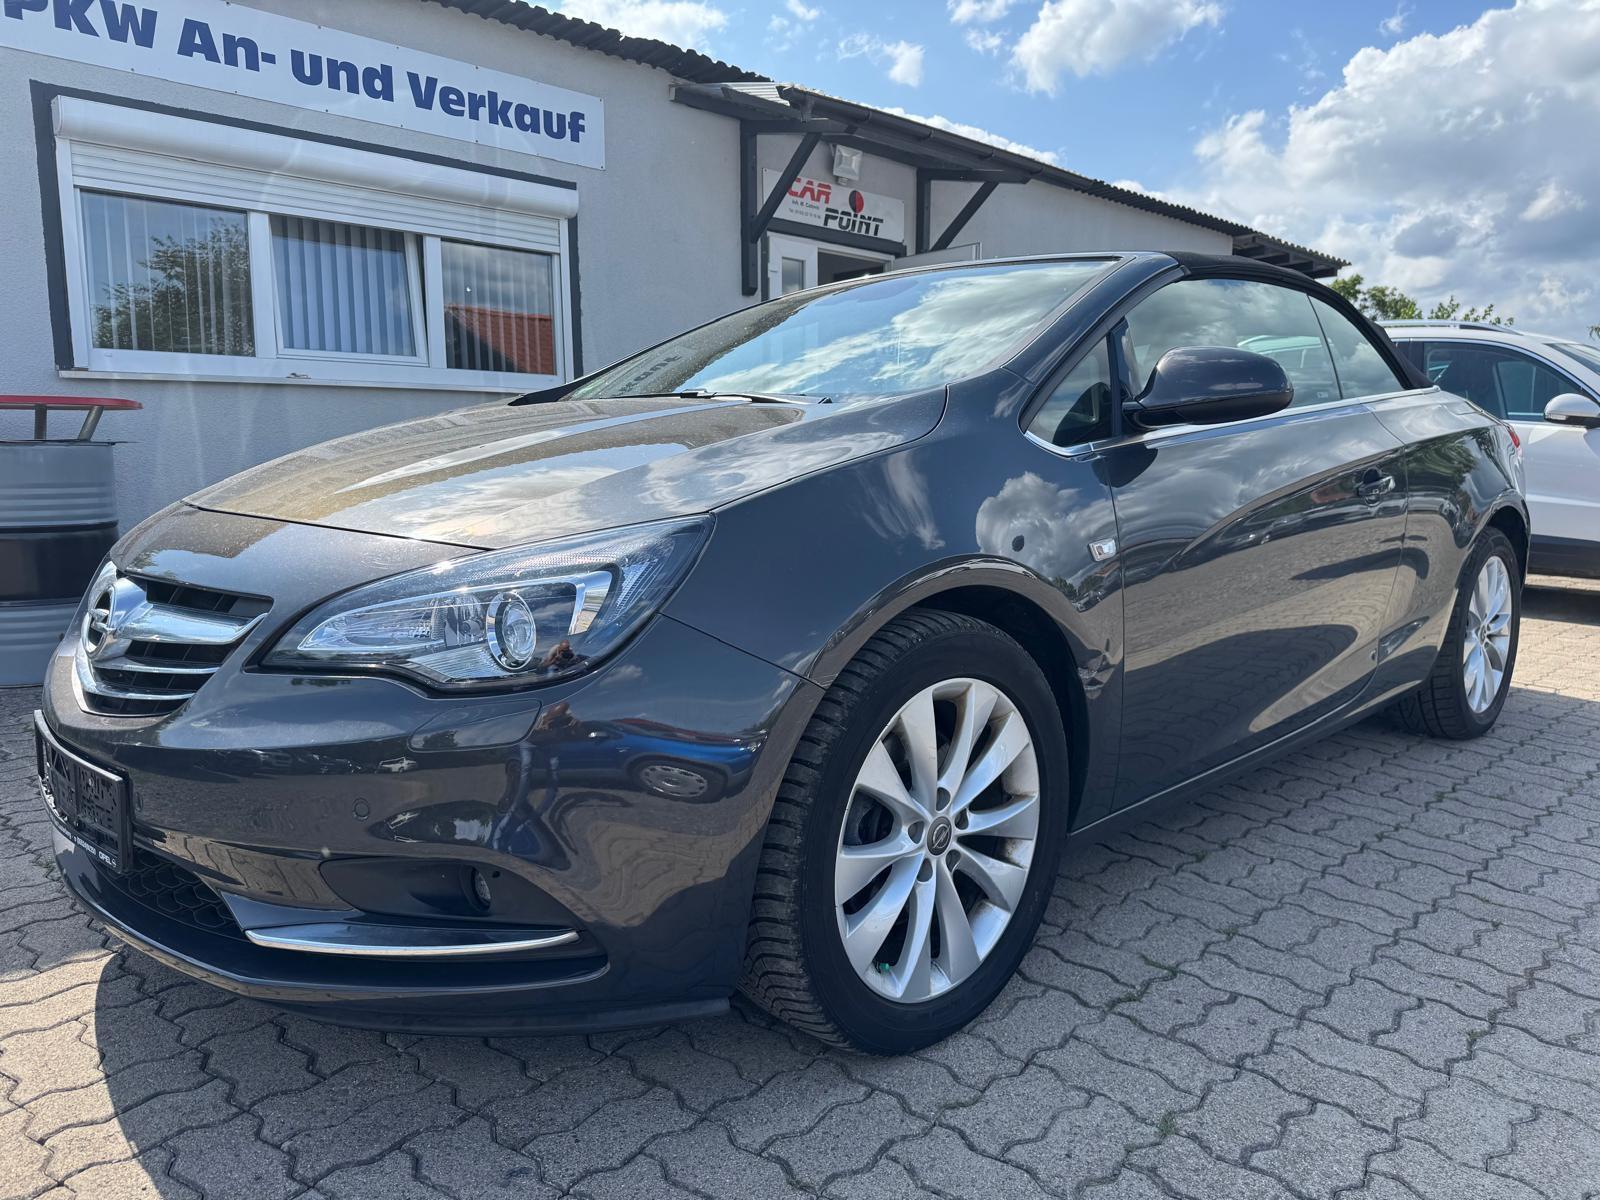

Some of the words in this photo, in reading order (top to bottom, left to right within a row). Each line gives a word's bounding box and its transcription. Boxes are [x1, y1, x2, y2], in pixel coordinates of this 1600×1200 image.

[177, 18, 276, 72] An-
[290, 49, 394, 103] und
[406, 71, 586, 144] Verkauf
[787, 176, 833, 204] CAR
[823, 207, 884, 237] POINT
